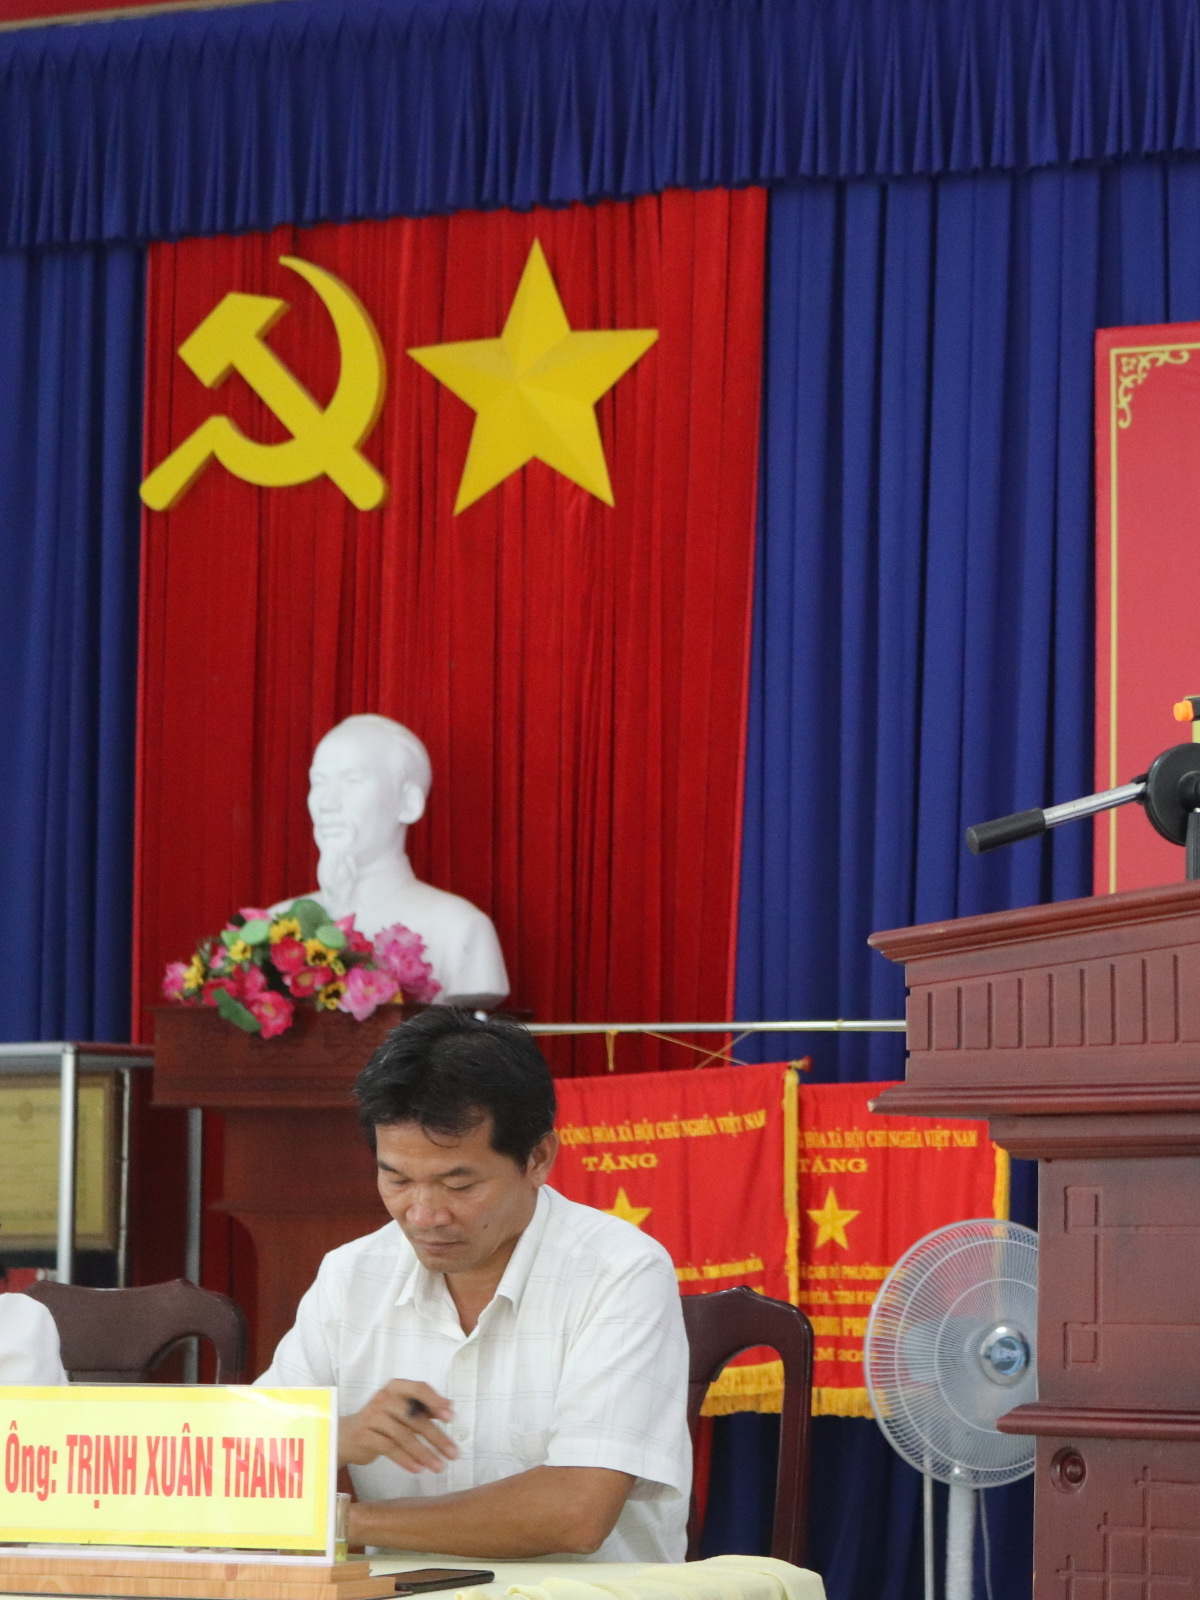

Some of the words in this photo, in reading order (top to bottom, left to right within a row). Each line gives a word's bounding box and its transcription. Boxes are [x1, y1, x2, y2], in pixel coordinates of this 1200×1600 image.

[582, 1152, 658, 1173] TẶNG
[5, 1420, 58, 1502] Ông:
[66, 1434, 138, 1509] TRỊNH
[144, 1422, 214, 1497] XUÂN
[222, 1436, 305, 1499] THANH
